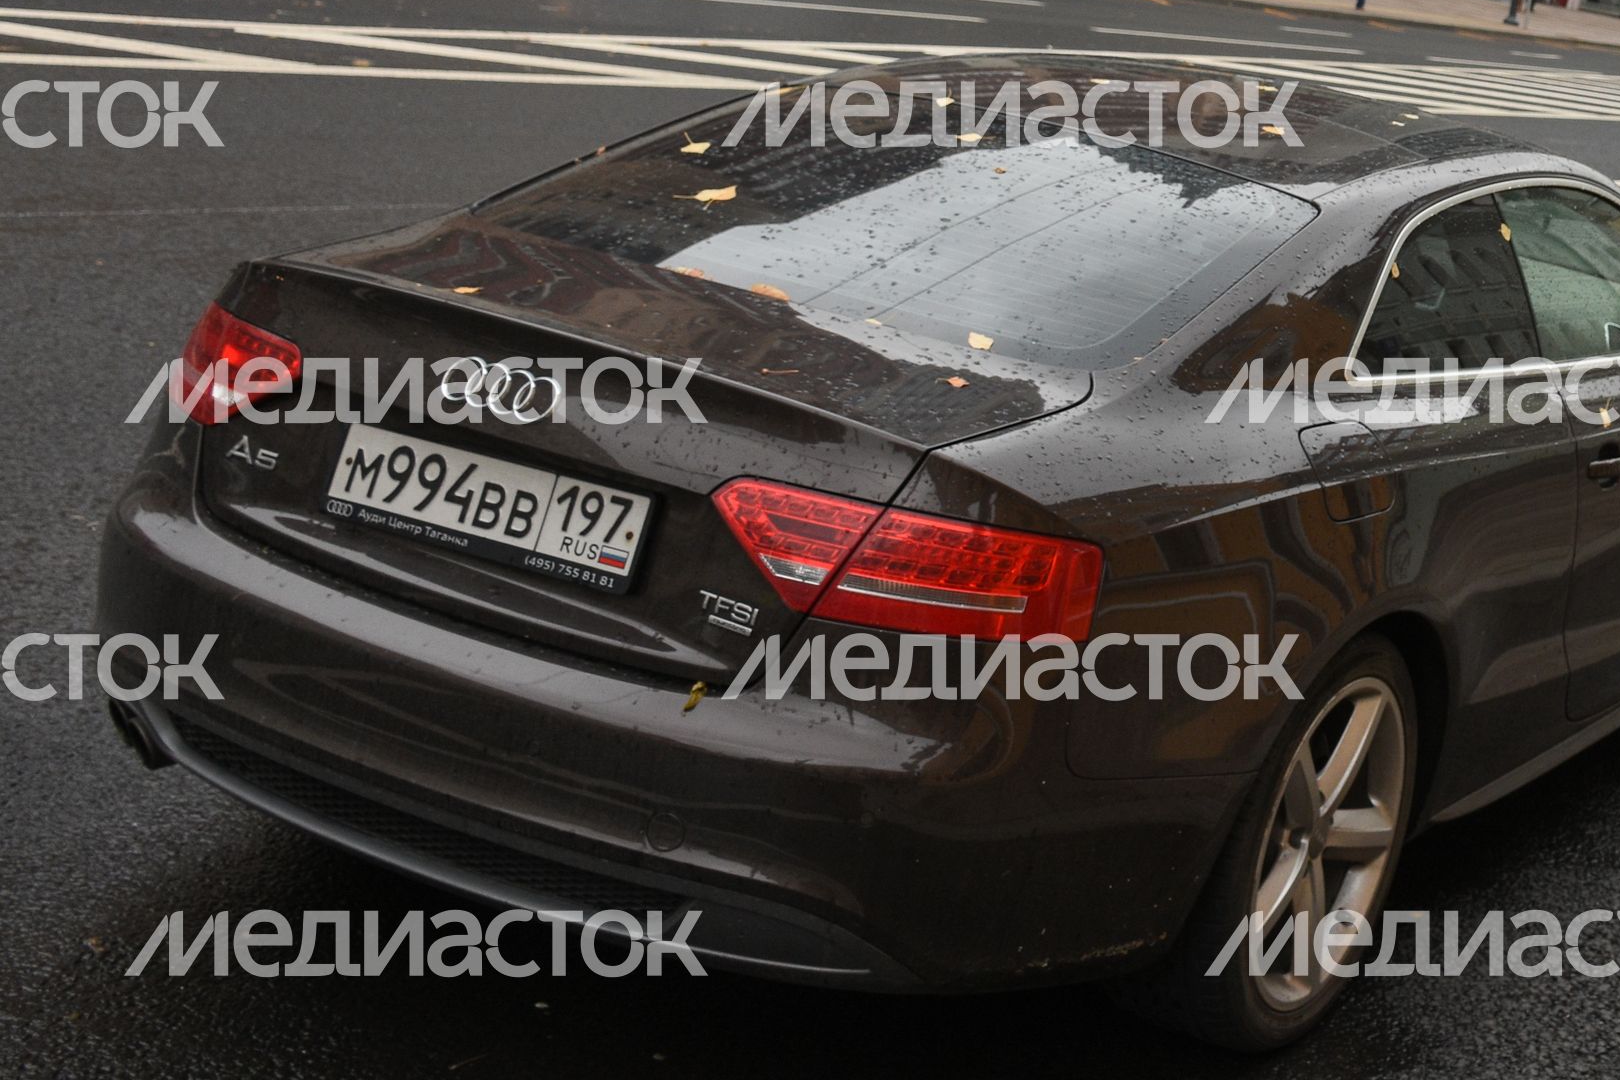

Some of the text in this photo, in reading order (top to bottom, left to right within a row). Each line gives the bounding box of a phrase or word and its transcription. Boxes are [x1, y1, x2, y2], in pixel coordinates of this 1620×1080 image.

[226, 434, 278, 472] A5
[357, 509, 469, 548] Ауди Центр Таганка
[556, 485, 634, 544] 197
[560, 536, 599, 562] RUS
[524, 554, 615, 588] (495) 755 81 81
[699, 589, 759, 626] TFSI
